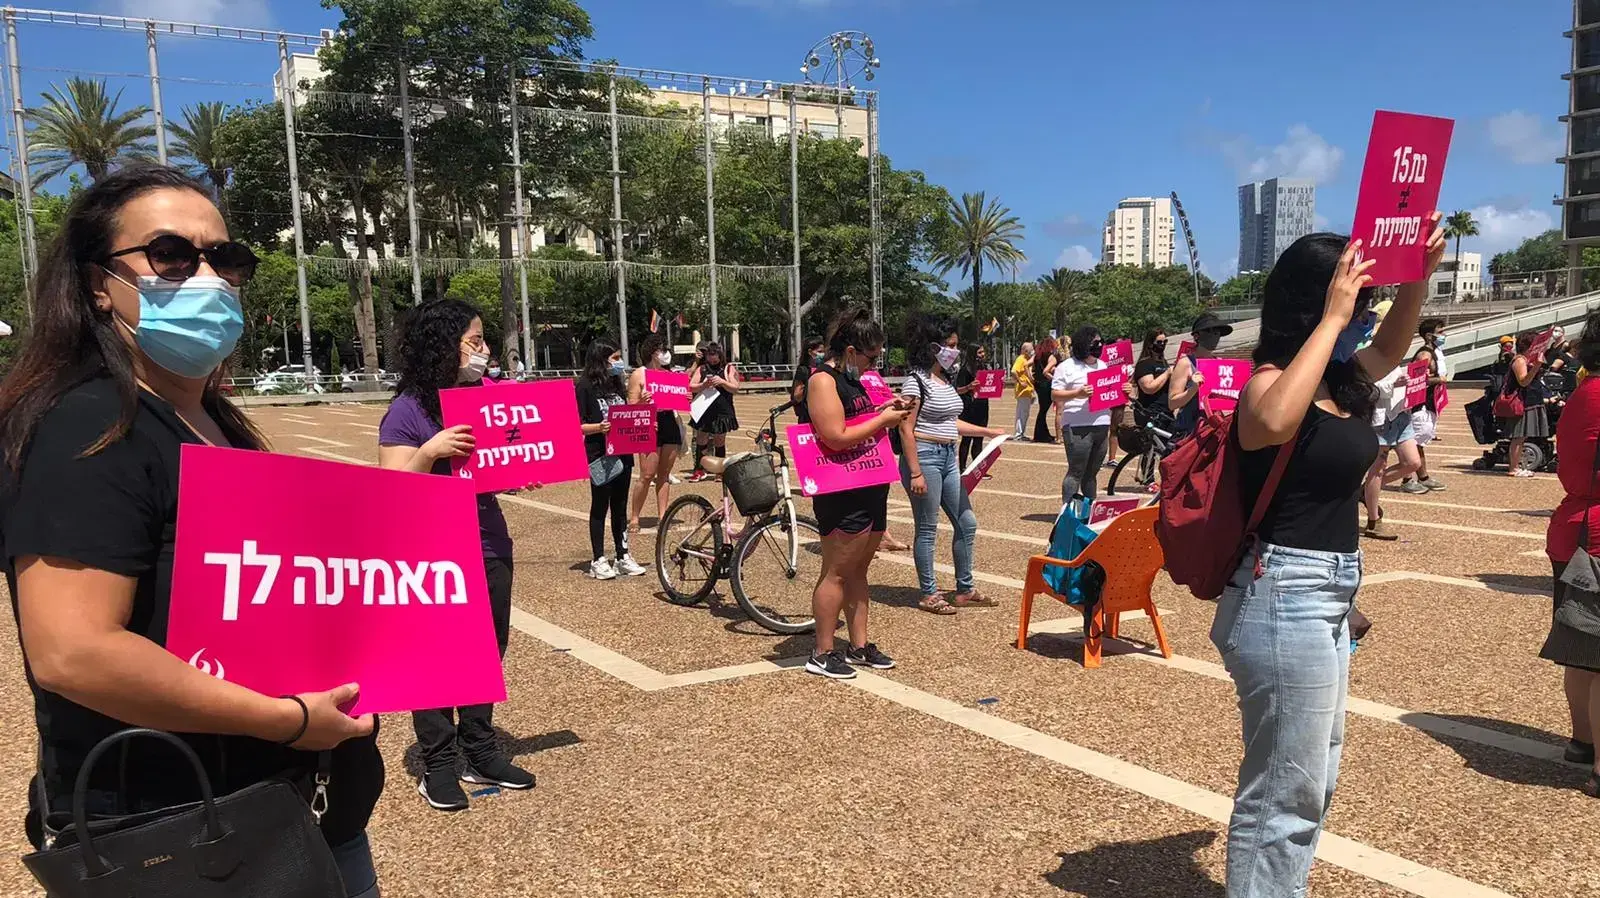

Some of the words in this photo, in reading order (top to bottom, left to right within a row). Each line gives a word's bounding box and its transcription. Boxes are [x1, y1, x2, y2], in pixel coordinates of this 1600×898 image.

[1392, 146, 1412, 183] 15
[1408, 153, 1427, 183] בת
[1370, 216, 1421, 248] פתיינית
[1218, 365, 1233, 376] את
[1219, 375, 1233, 388] לא
[648, 382, 659, 394] לך
[659, 384, 688, 394] מאמינה
[479, 403, 508, 428] 15
[510, 403, 541, 425] בת
[477, 440, 555, 469] פתיינית
[858, 458, 884, 470] בנות
[843, 462, 857, 472] 15
[204, 539, 281, 621] לך
[293, 555, 468, 605] מאמינה
